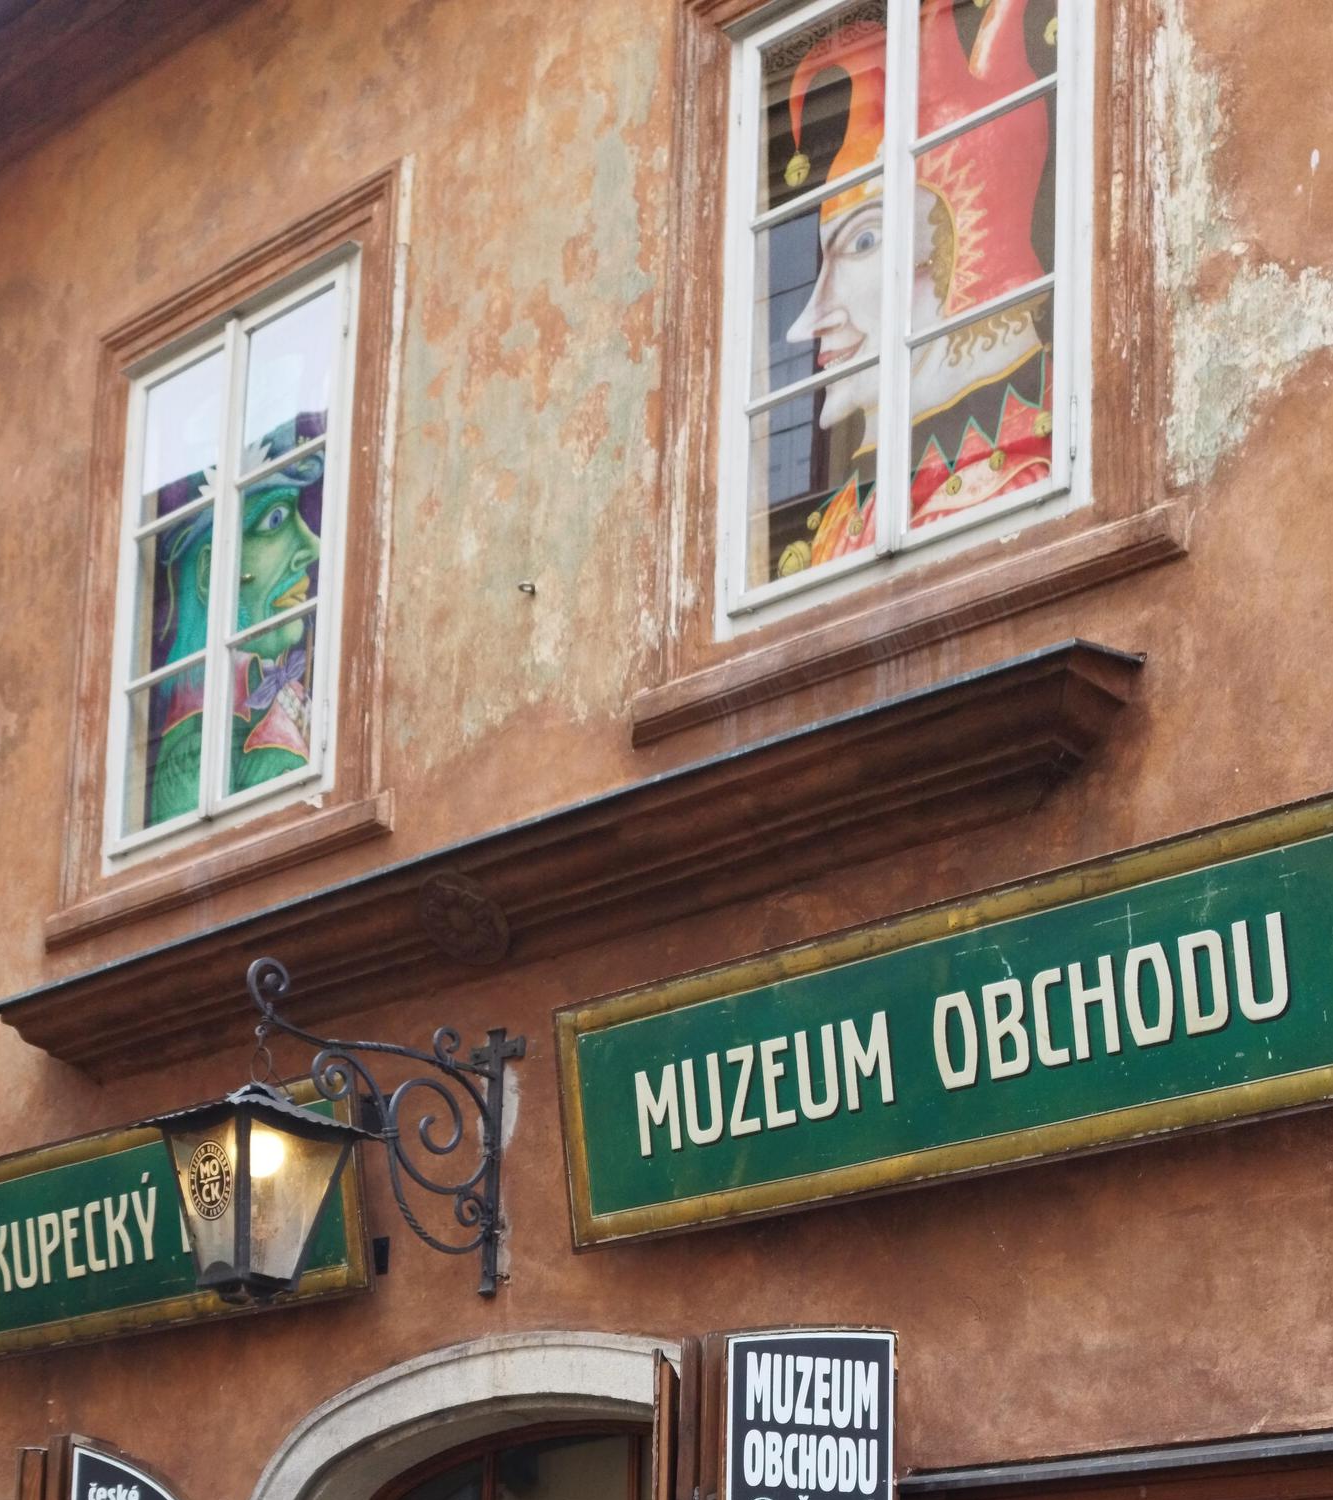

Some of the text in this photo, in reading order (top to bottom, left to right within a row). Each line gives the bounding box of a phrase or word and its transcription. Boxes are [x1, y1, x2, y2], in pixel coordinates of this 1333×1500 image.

[634, 911, 1290, 1157] MUZEUM OBCHODU
[199, 1158, 220, 1179] MO
[746, 1351, 879, 1430] MUZEUM
[743, 1429, 878, 1494] OBCHODU
